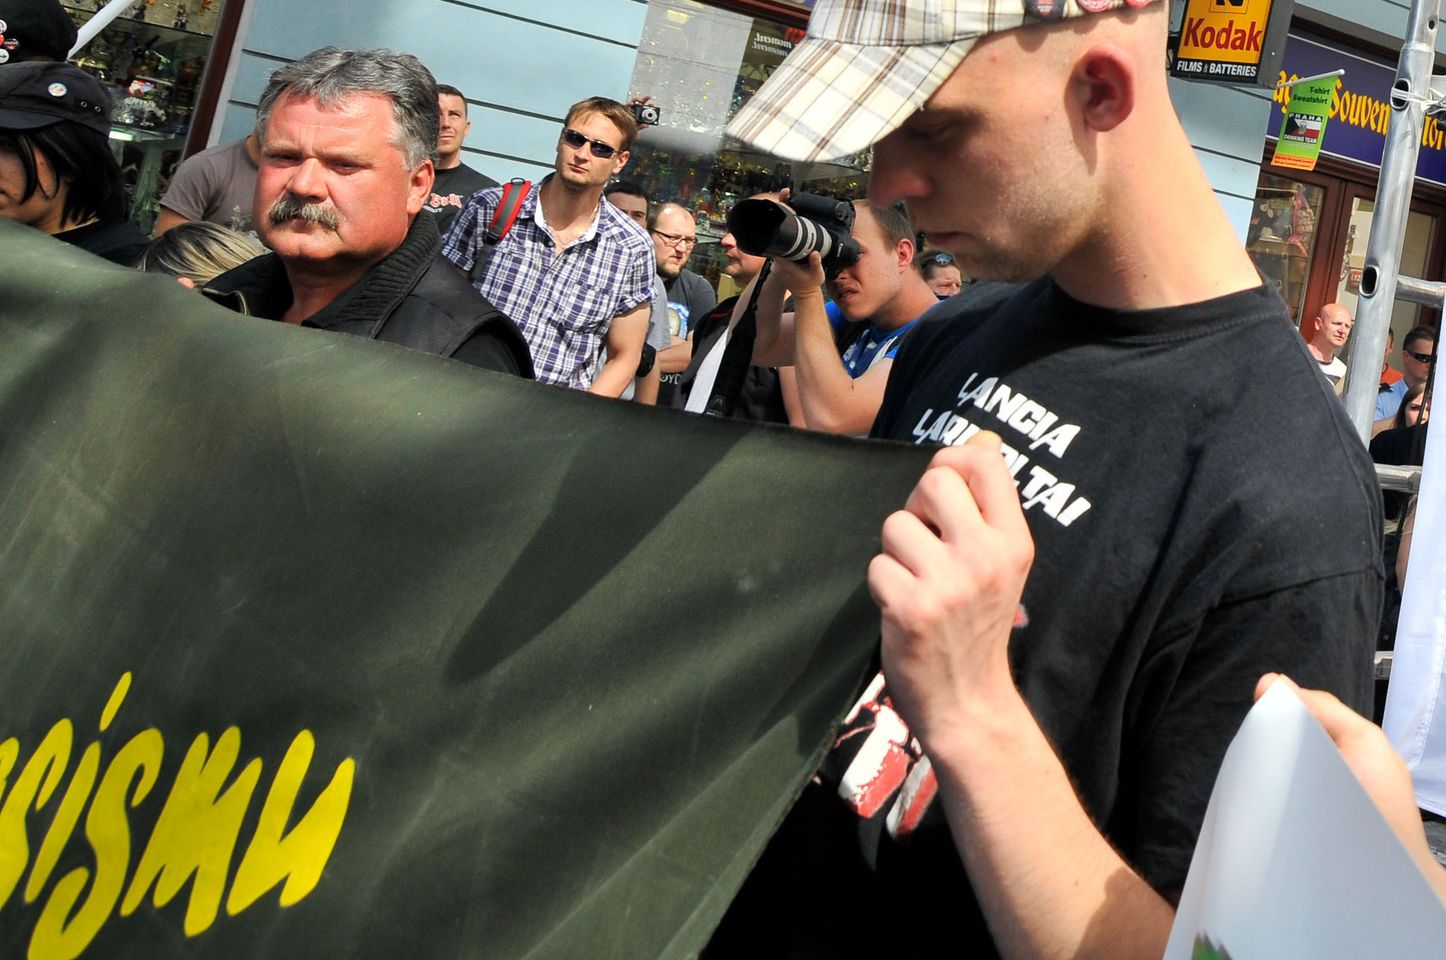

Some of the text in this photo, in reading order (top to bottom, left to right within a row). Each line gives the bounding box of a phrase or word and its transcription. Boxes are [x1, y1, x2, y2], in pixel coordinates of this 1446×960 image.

[1183, 16, 1263, 52] Kodak
[1177, 60, 1203, 73] FILMS
[1209, 63, 1257, 77] BATTERIES
[1309, 86, 1331, 95] T-shirt
[1293, 94, 1328, 104] Sweatshirt
[1289, 112, 1322, 122] PRAHA
[957, 372, 1082, 459] LANCIA
